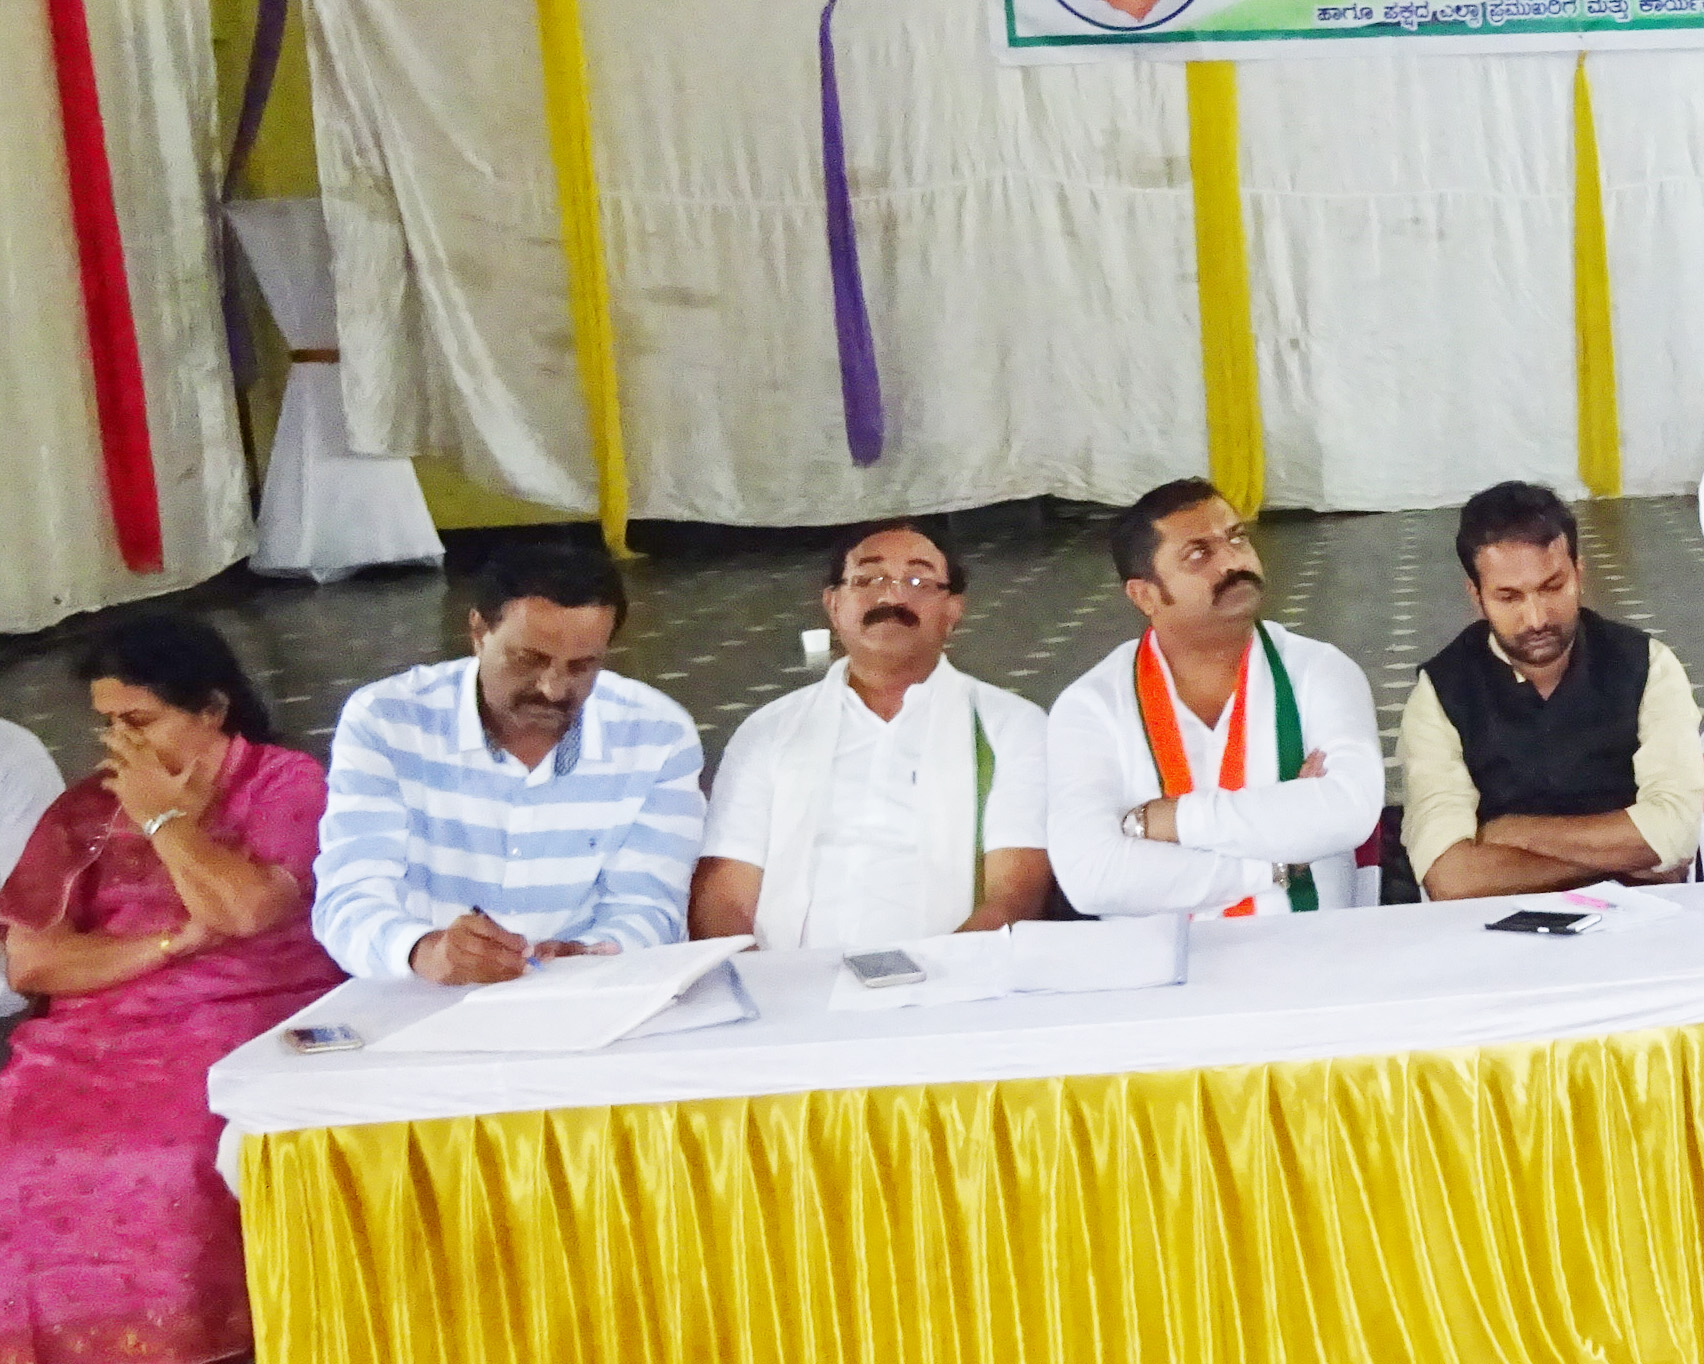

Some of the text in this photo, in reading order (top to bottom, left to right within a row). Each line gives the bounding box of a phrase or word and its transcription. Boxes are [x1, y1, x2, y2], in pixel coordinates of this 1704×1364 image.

[1317, 4, 1374, 21] ಹಾಗೂ
[1383, 1, 1429, 27] ಪಕ್ಷದ
[1587, 0, 1629, 20] ಮತ್ತು
